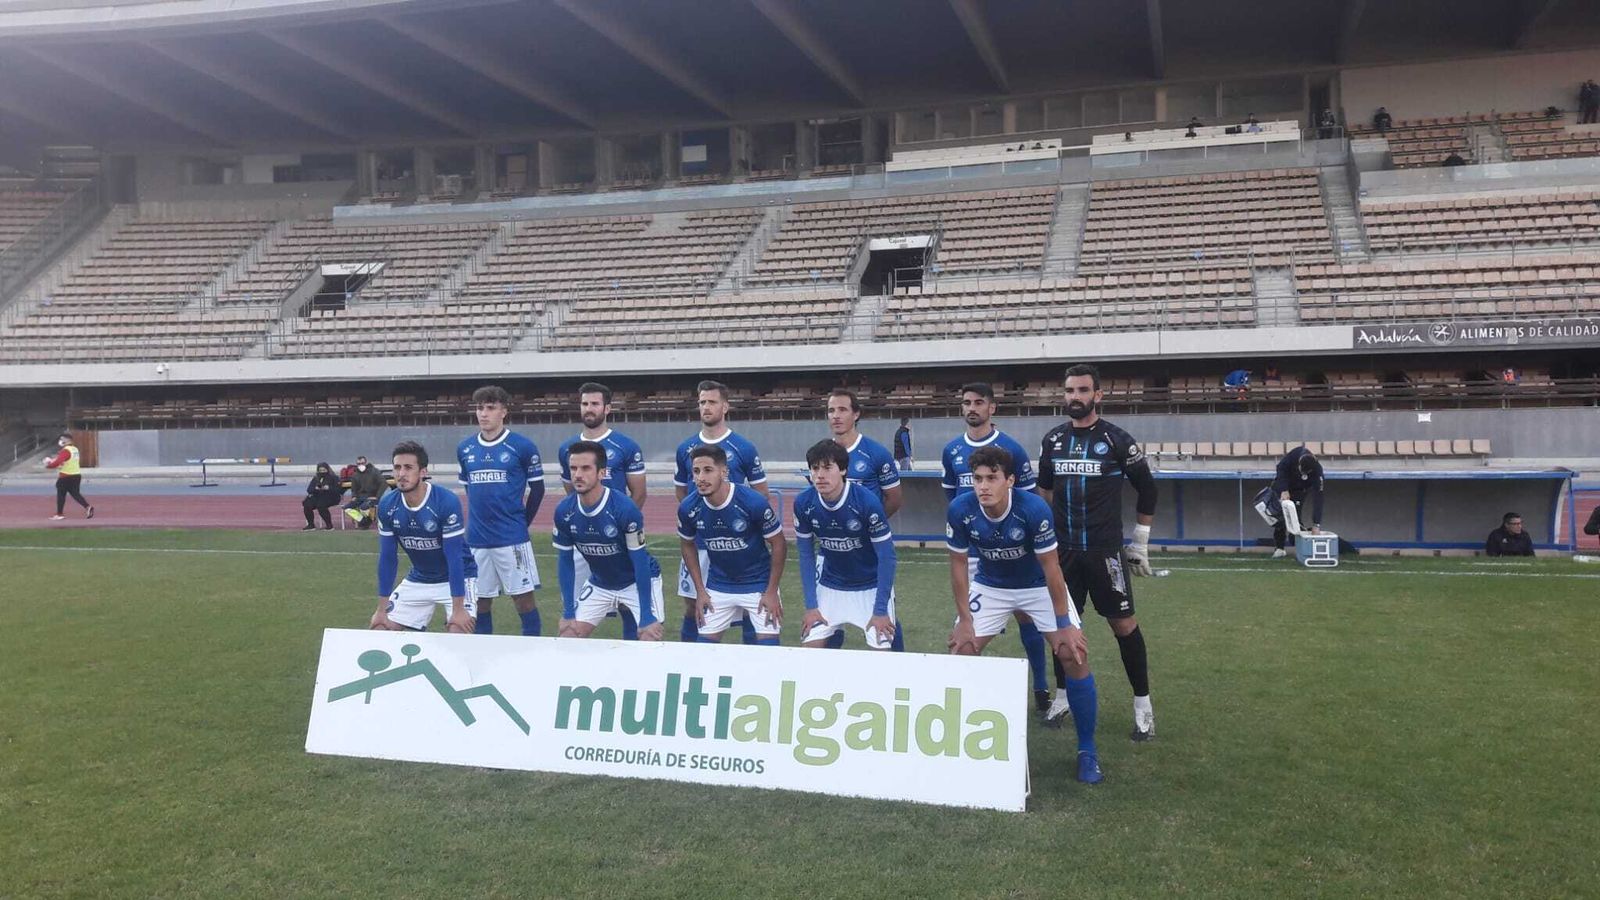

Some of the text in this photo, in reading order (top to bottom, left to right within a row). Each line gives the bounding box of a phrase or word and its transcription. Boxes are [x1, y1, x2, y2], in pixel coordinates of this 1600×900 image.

[1357, 328, 1425, 344] Andalucía
[1460, 326, 1525, 339] ALIMENTOS
[1529, 326, 1543, 337] DE
[1548, 325, 1599, 337] CALIDAD
[1054, 462, 1102, 474] RANABE
[554, 673, 1010, 766] multialgaida
[564, 745, 765, 774] CORREDURÍA DE SEGUROS
